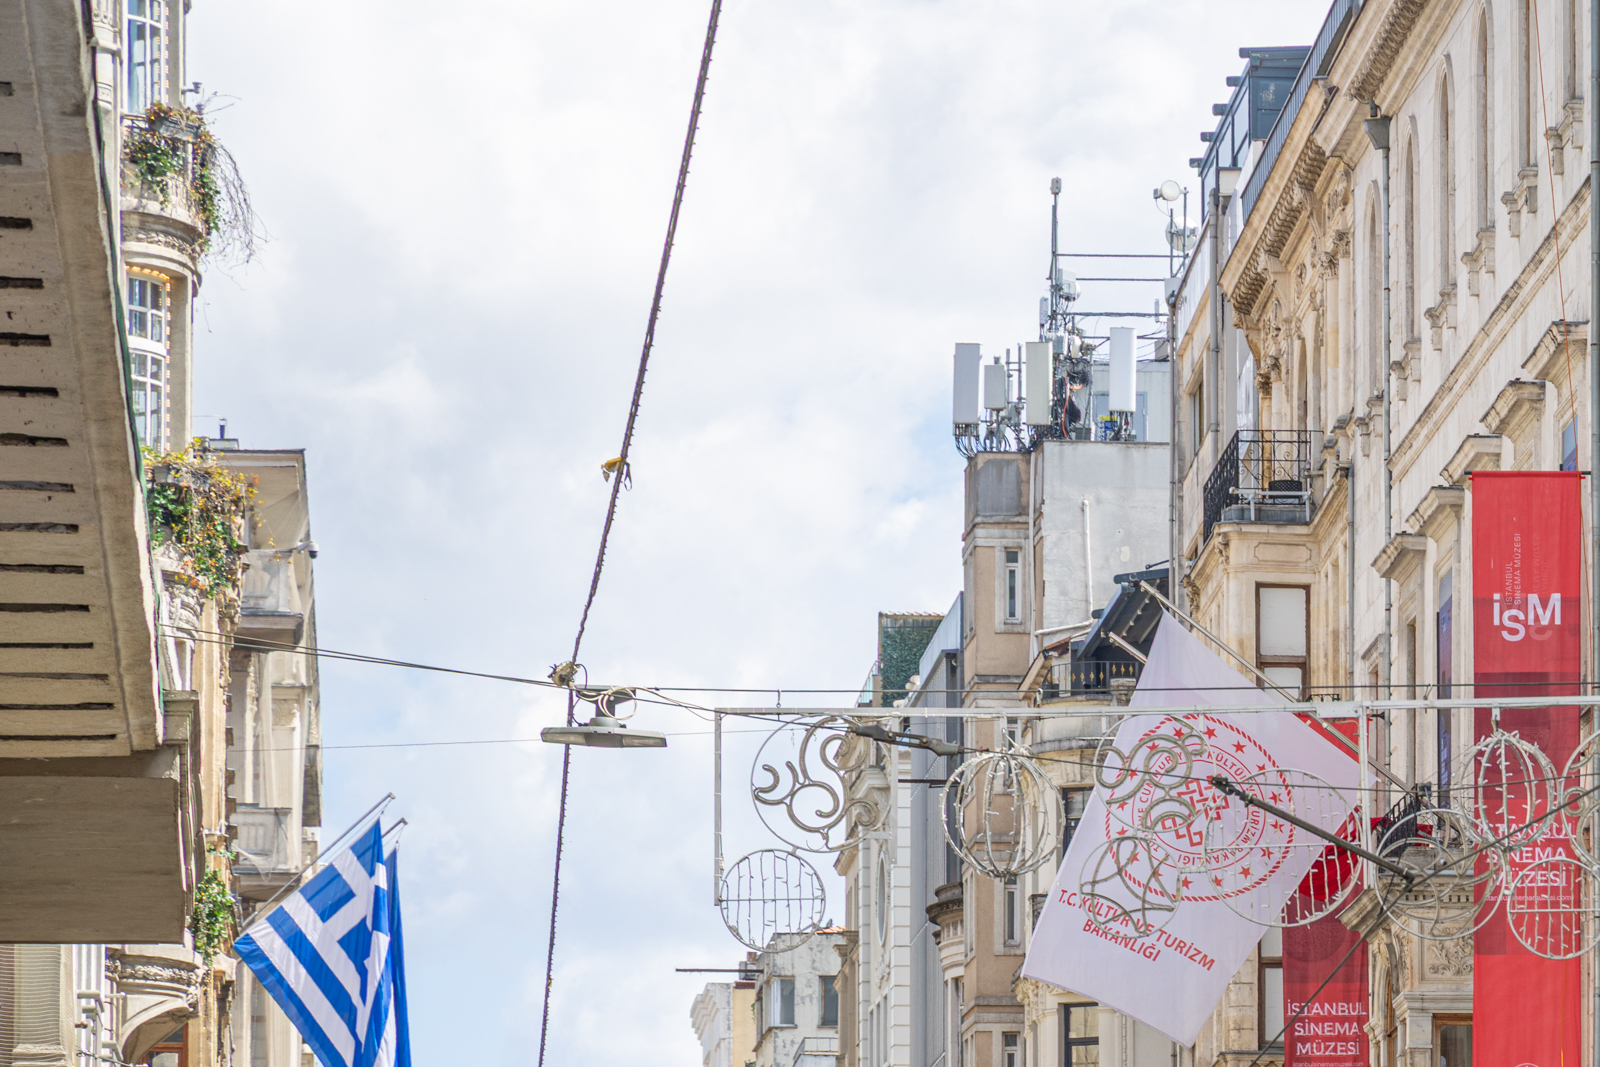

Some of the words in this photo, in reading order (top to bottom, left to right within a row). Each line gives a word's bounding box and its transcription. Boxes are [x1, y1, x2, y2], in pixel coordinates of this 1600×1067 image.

[1486, 846, 1567, 863] SNEMA
[1058, 889, 1076, 907] T.C.
[1156, 928, 1215, 972] TURİZM
[1083, 918, 1162, 962] BAKANLIĞI
[1287, 998, 1368, 1016] İSTANBUL
[1294, 1019, 1361, 1036] SİNEMA
[1296, 1038, 1361, 1056] MÜZESİ
